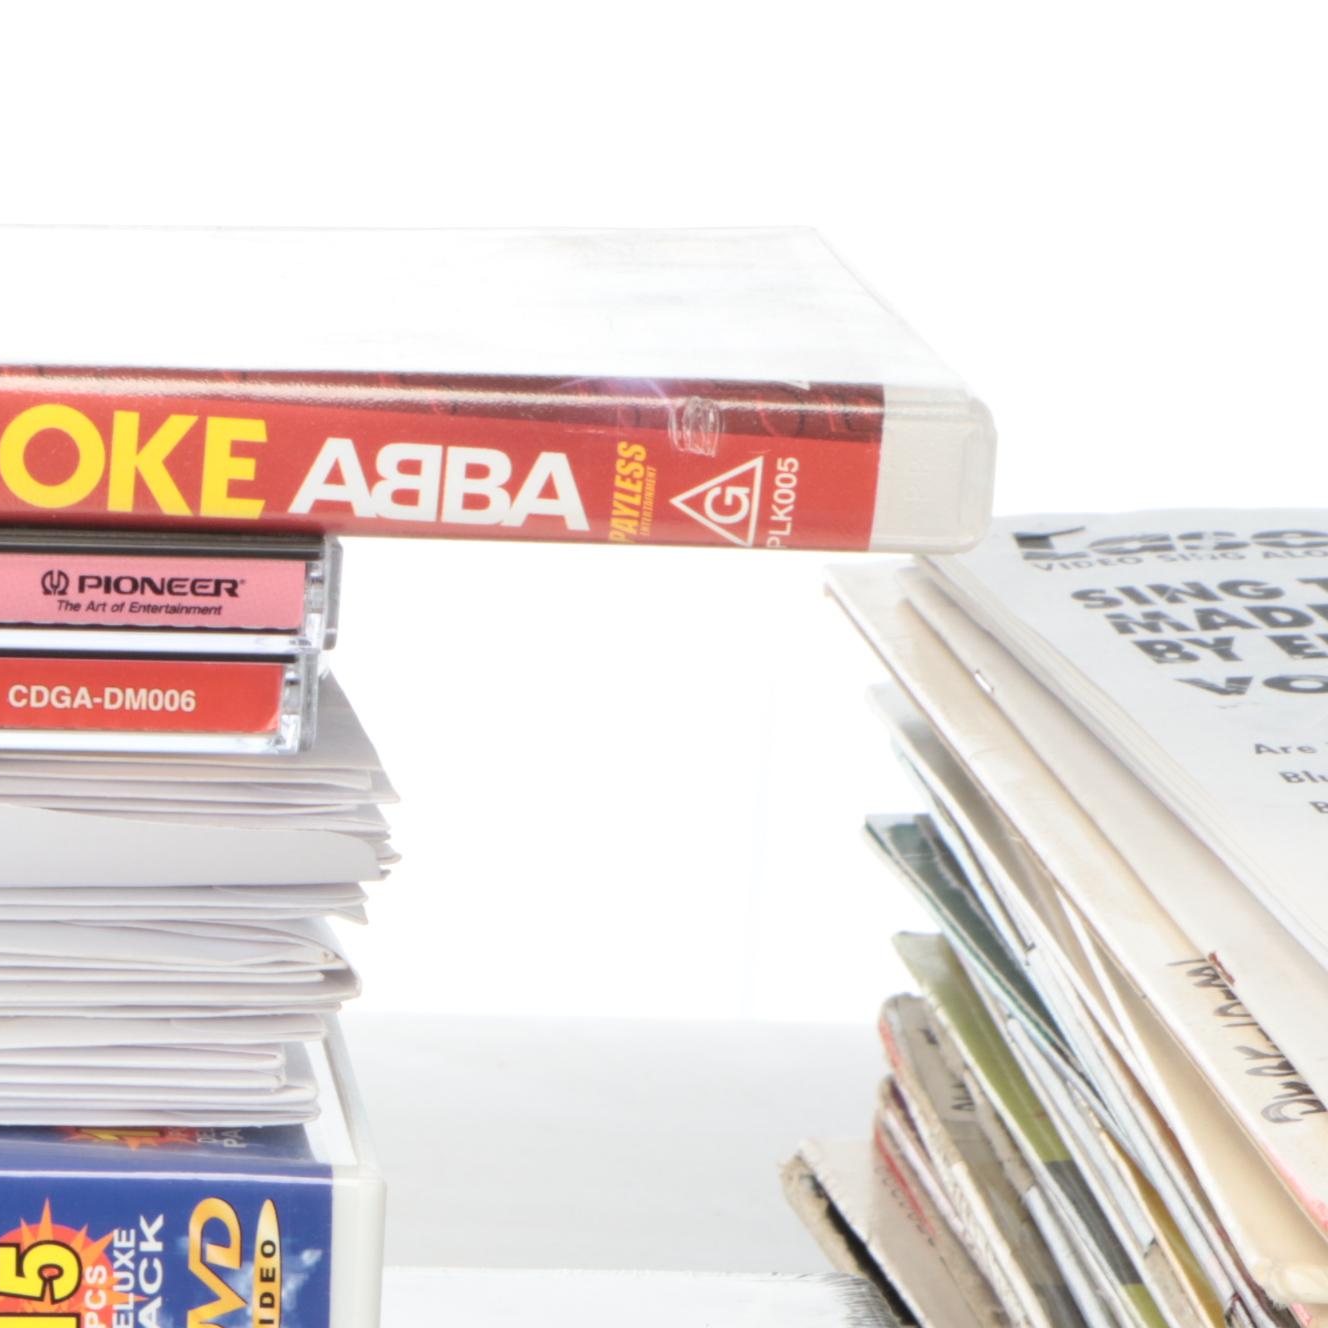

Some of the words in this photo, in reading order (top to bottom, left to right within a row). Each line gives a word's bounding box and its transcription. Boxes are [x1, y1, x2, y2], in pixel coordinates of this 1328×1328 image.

[287, 437, 590, 531] ABBA
[608, 441, 648, 543] PAYLESS
[703, 486, 750, 524] G
[765, 457, 800, 548] PLK005
[1034, 556, 1144, 571] VIDEO
[77, 574, 240, 599] PIONEER
[1071, 579, 1285, 609] SING
[56, 599, 82, 612] The
[85, 600, 108, 613] Art
[110, 601, 126, 614] of
[128, 602, 223, 616] Entertainment
[1132, 636, 1244, 664] BY
[7, 684, 197, 715] CDGA-DM006
[1253, 743, 1318, 755] Are
